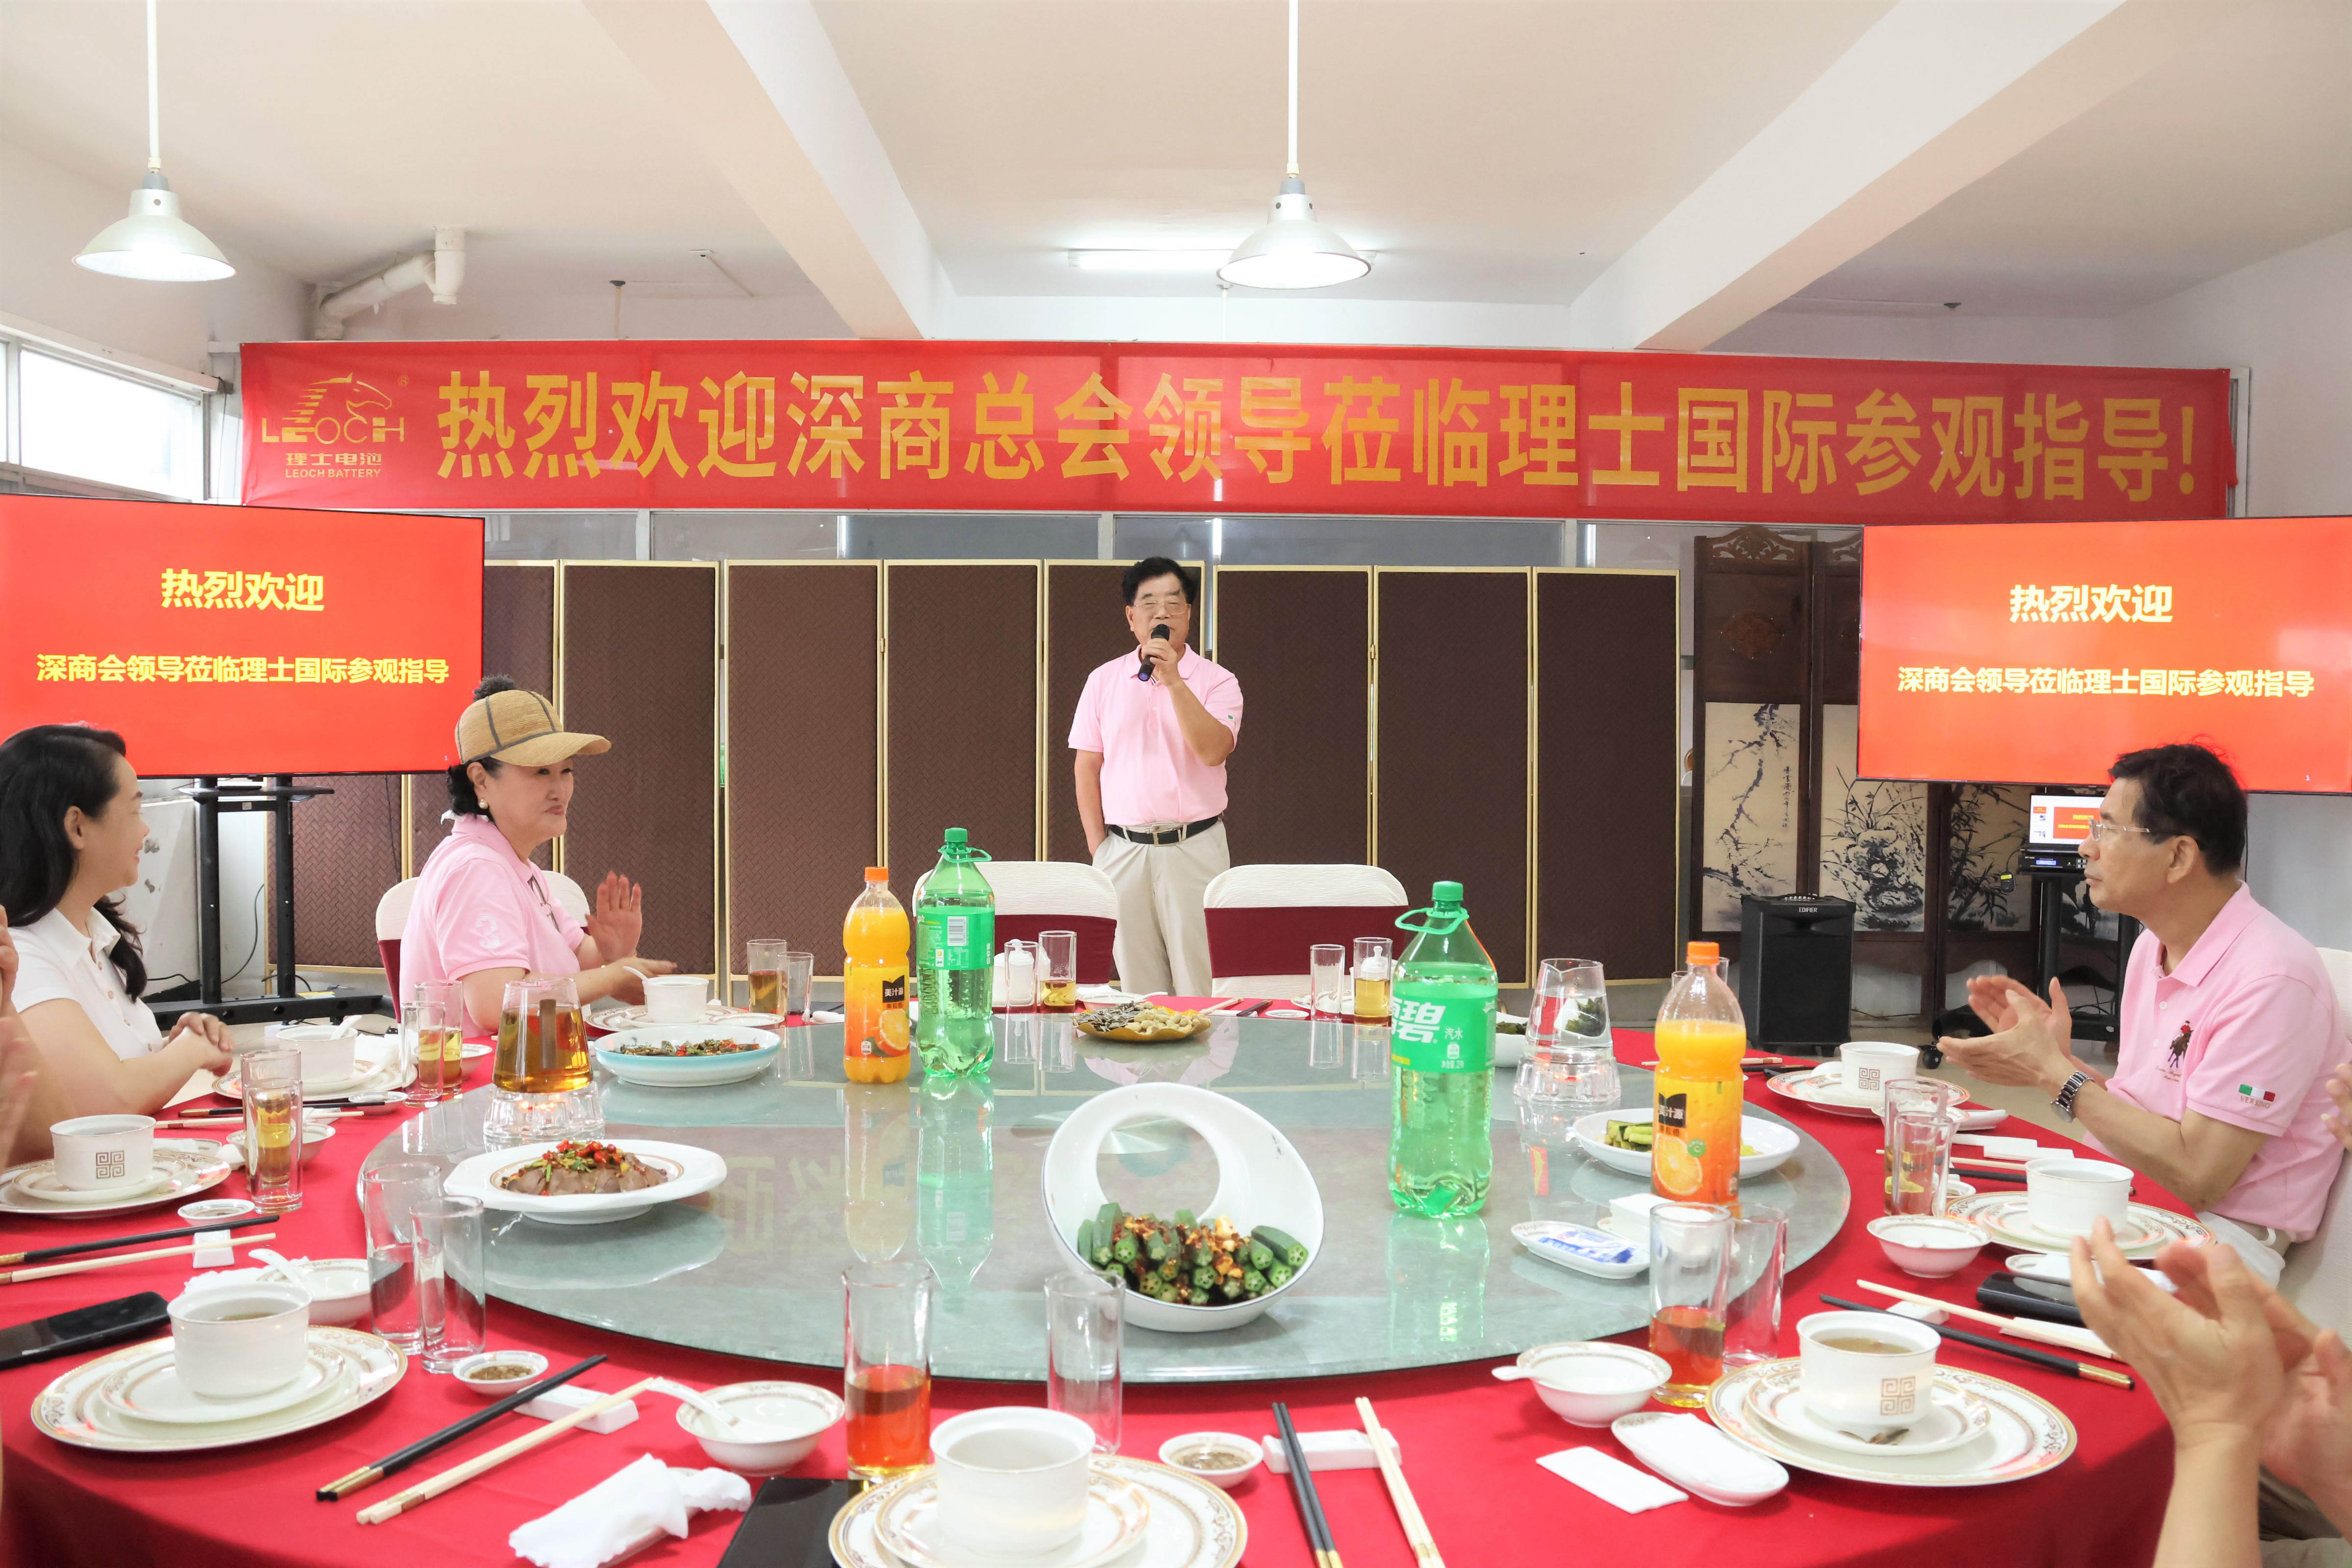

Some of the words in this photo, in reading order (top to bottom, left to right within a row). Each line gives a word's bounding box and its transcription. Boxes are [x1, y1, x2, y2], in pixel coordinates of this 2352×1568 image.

[262, 417, 404, 444] LEOCH
[437, 370, 2194, 502] 热烈欢迎深商总会领导莅临理士国际参观指导!
[285, 468, 324, 478] LEOCH
[328, 468, 381, 478] BATTERY
[286, 453, 382, 466] 理士电池
[161, 568, 325, 612] 热烈欢迎
[2009, 584, 2173, 623] 热烈欢迎
[36, 654, 449, 684] 深商会领导莅临理士国际参观指导
[1898, 666, 2314, 697] 深商会领导莅临理士国际参观指导
[474, 914, 501, 949] 3
[884, 987, 904, 997] 美汁源
[1445, 1028, 1463, 1040] 汽水
[1658, 1104, 1684, 1120] 美汁源
